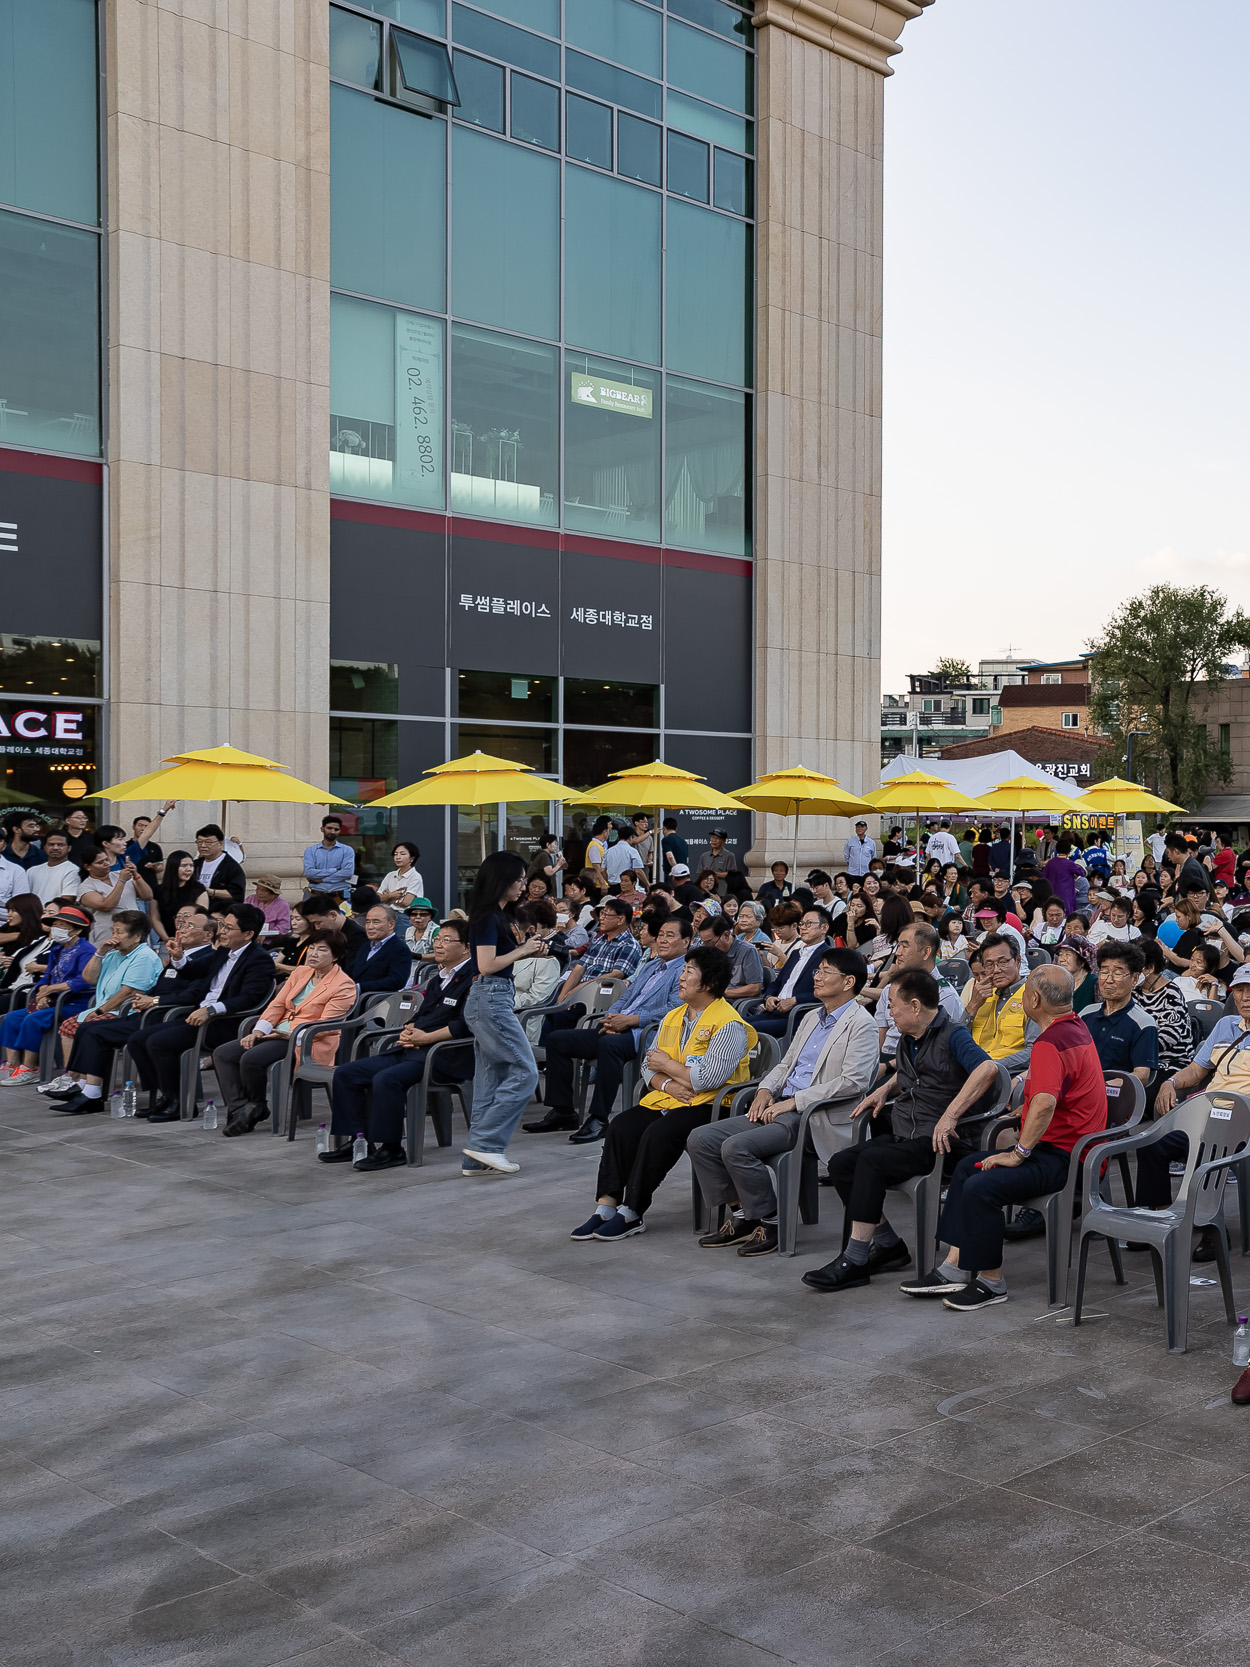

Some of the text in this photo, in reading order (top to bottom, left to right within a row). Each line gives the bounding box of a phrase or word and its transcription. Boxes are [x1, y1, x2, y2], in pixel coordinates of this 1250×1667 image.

[406, 367, 423, 391] 02.
[411, 396, 429, 430] 462.
[416, 434, 436, 478] 8802.
[458, 593, 654, 630] 투썸플레이스 세종대학교점
[35, 746, 84, 756] 세종대학교점
